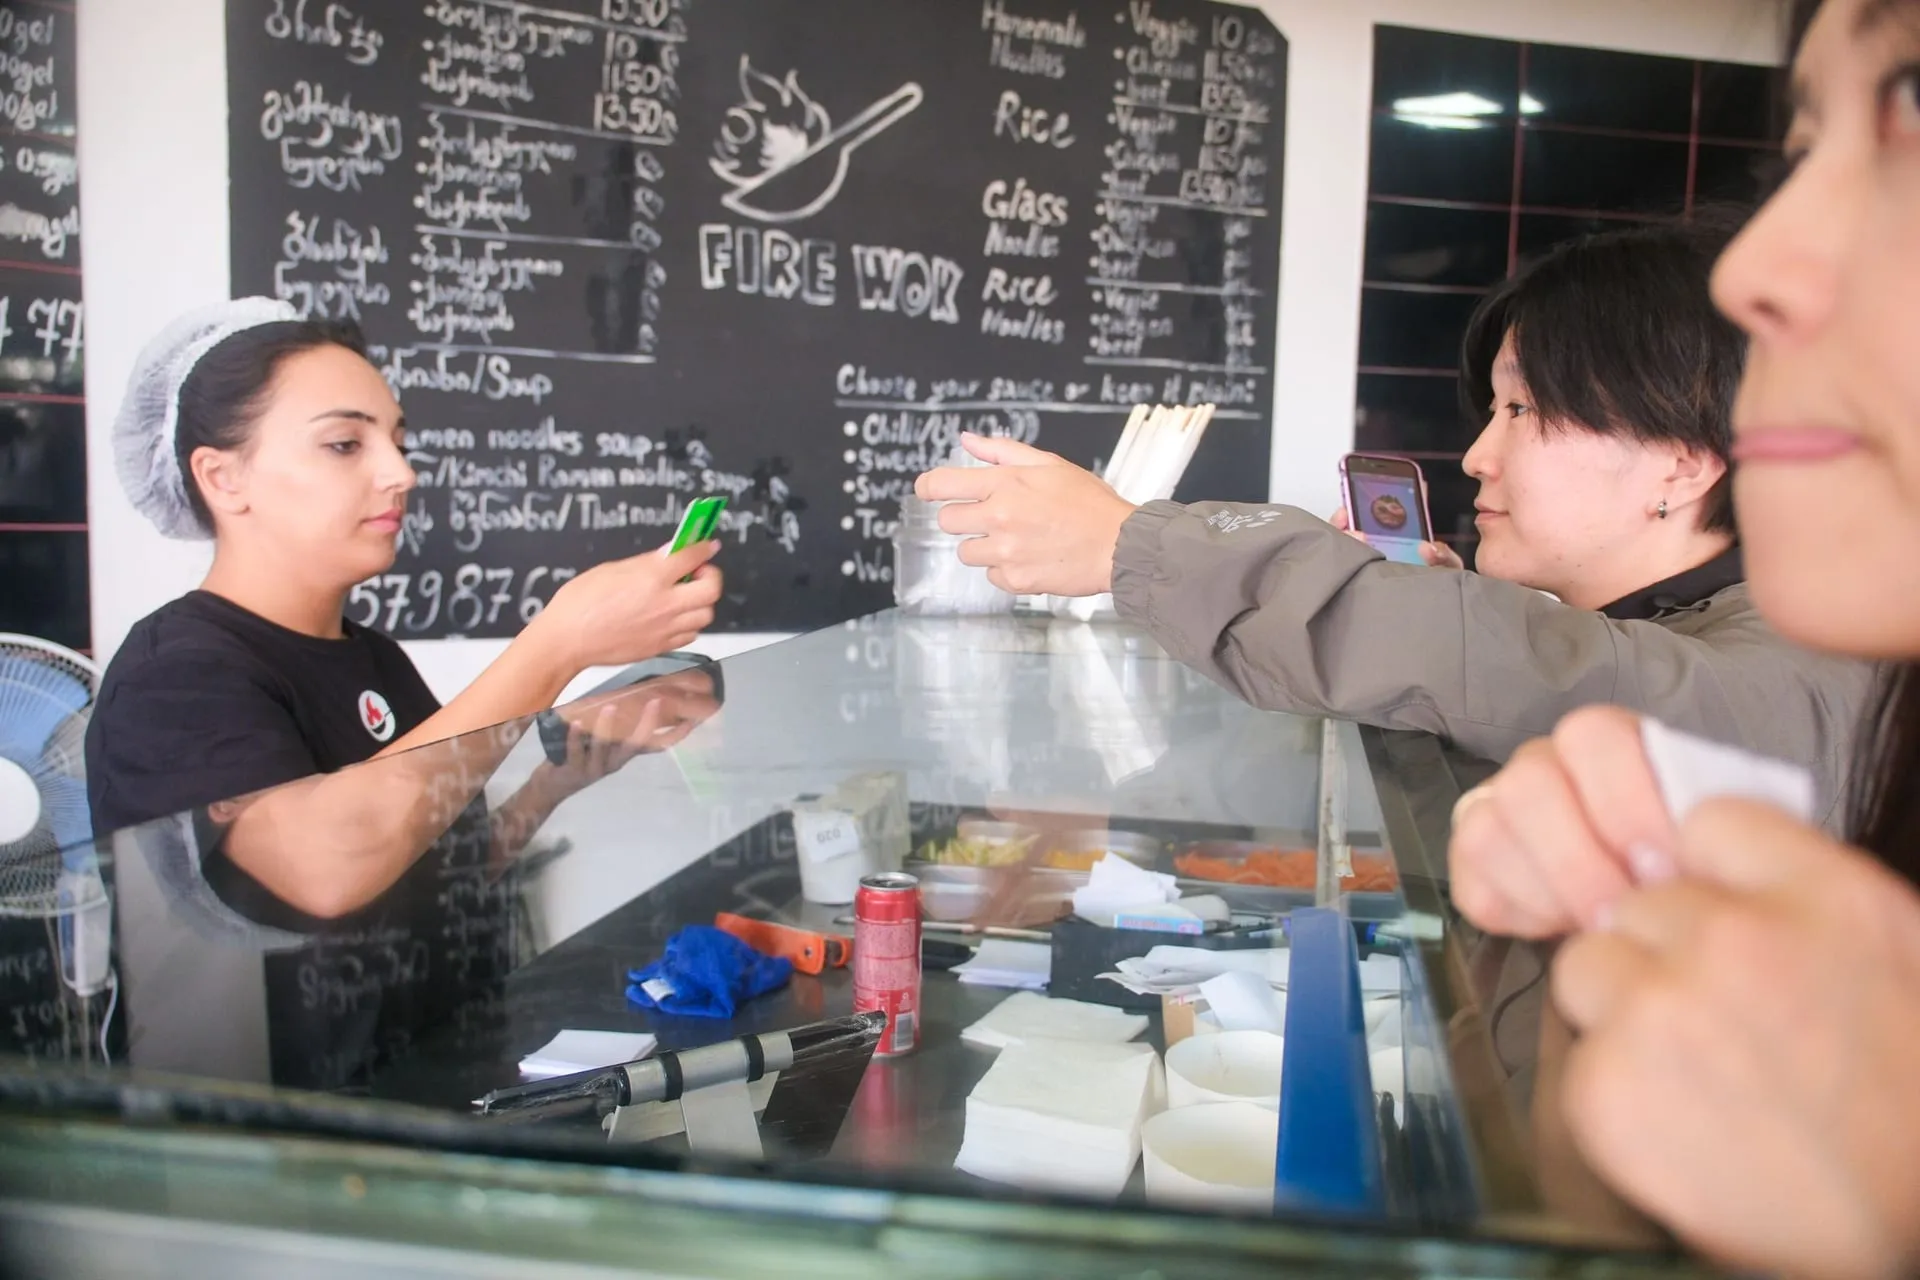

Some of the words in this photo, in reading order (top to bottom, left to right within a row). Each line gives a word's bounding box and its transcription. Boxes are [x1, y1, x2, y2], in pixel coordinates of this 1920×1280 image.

[993, 89, 1077, 149] Rice
[982, 178, 1068, 227] Glass
[699, 223, 836, 306] FIRE
[850, 244, 964, 324] WOK
[982, 267, 1059, 306] Rice
[836, 363, 917, 401] Choose
[930, 378, 981, 409] your
[988, 376, 1056, 401] sauce
[1065, 382, 1090, 401] or
[488, 416, 583, 456] noodles
